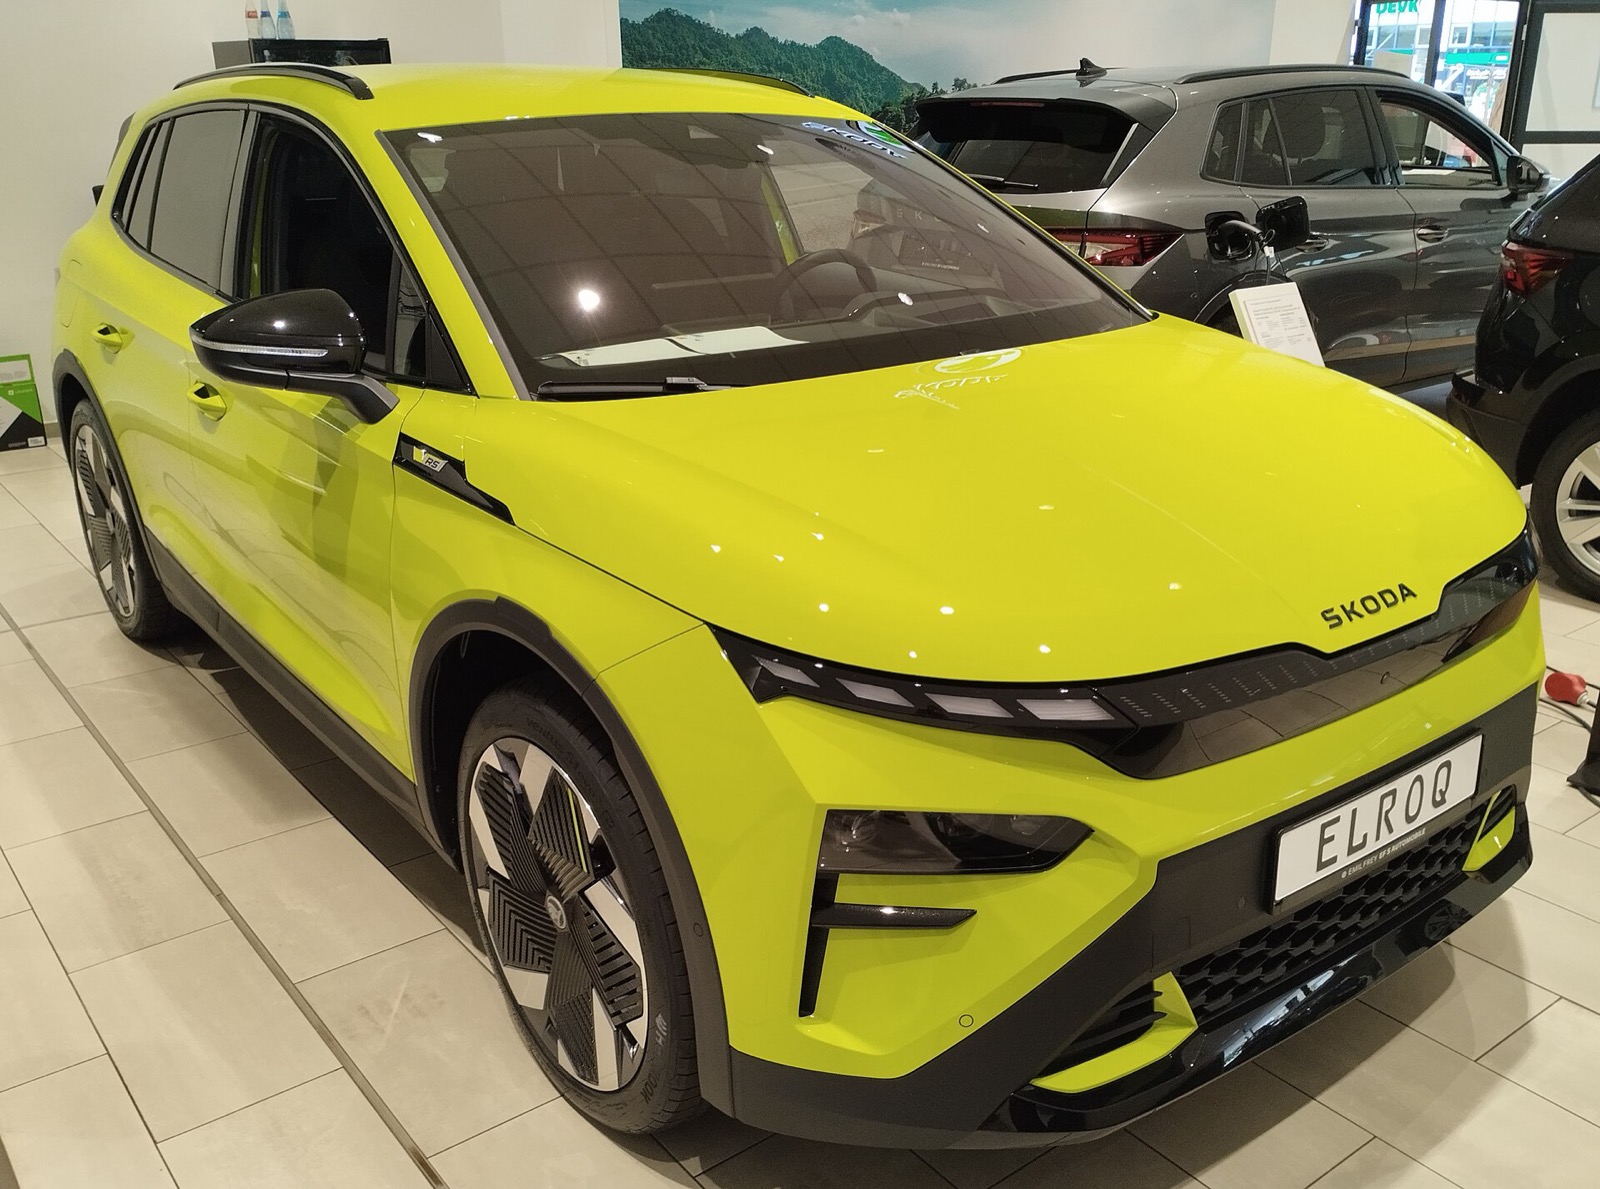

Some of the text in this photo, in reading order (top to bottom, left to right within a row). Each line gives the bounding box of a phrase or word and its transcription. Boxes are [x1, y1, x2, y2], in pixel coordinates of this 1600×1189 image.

[1376, 0, 1418, 14] DEVK
[424, 457, 440, 469] RS
[1320, 583, 1418, 630] SKODA
[1316, 759, 1452, 873] ELROQ
